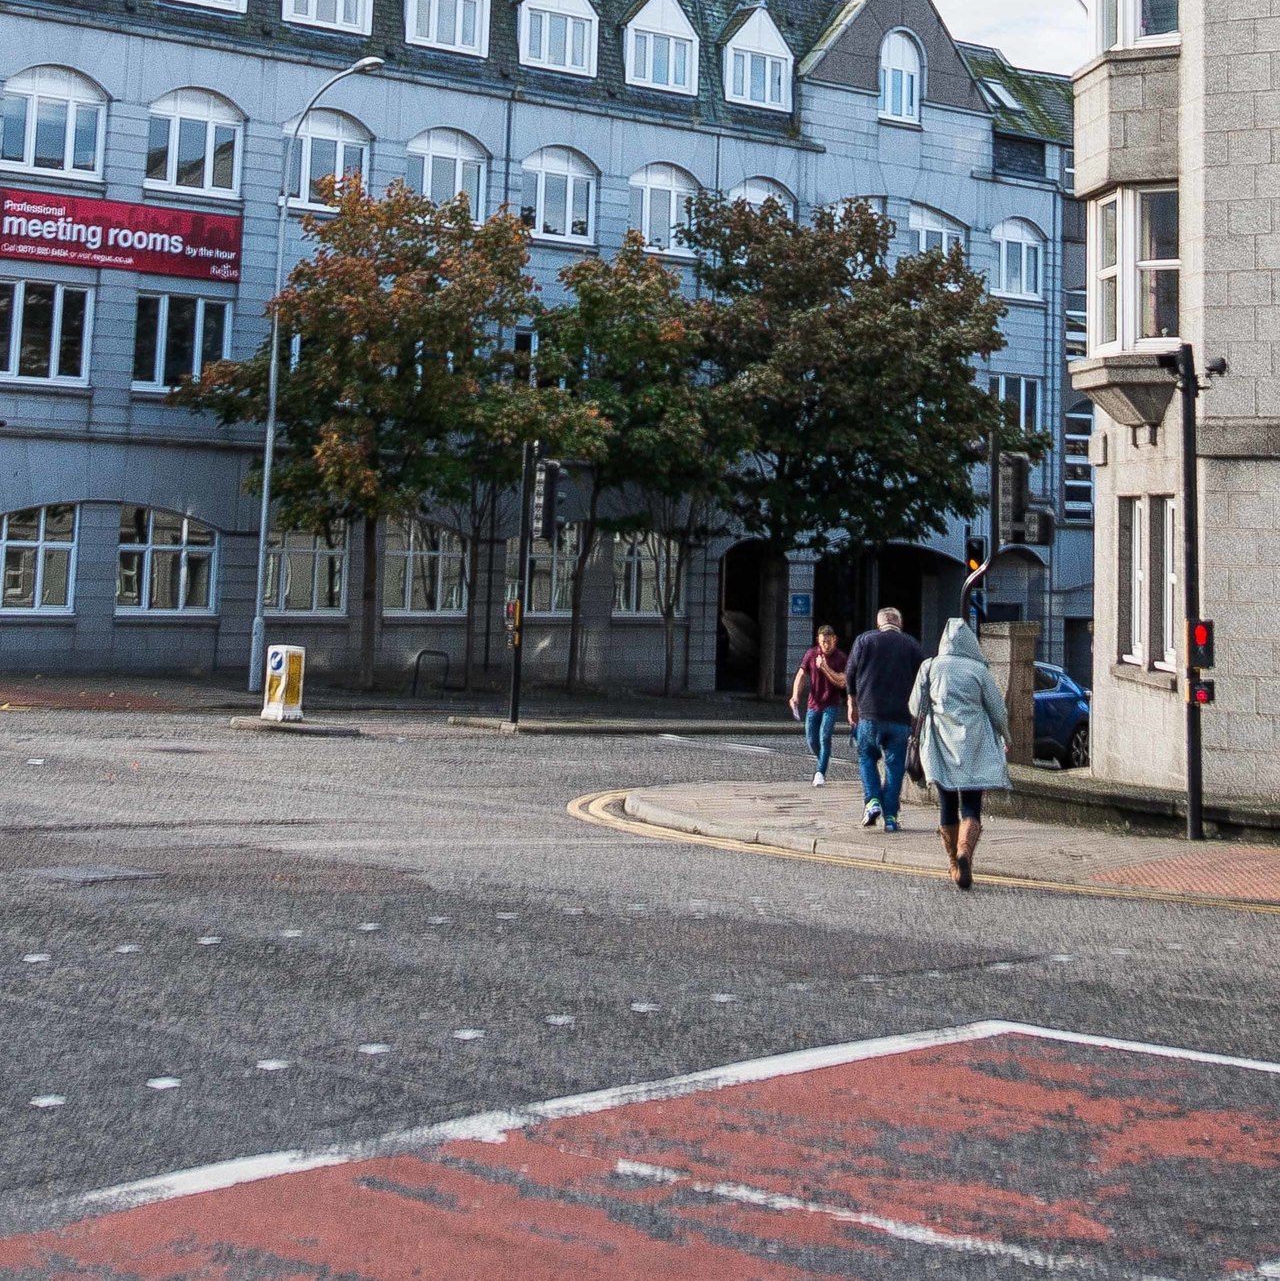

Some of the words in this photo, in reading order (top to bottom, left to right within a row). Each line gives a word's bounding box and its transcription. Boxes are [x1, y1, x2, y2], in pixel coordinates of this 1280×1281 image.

[4, 199, 66, 217] Professional
[2, 215, 102, 250] meeting
[107, 227, 184, 254] rooms
[185, 245, 198, 257] by
[198, 246, 214, 258] the
[214, 248, 237, 260] hour
